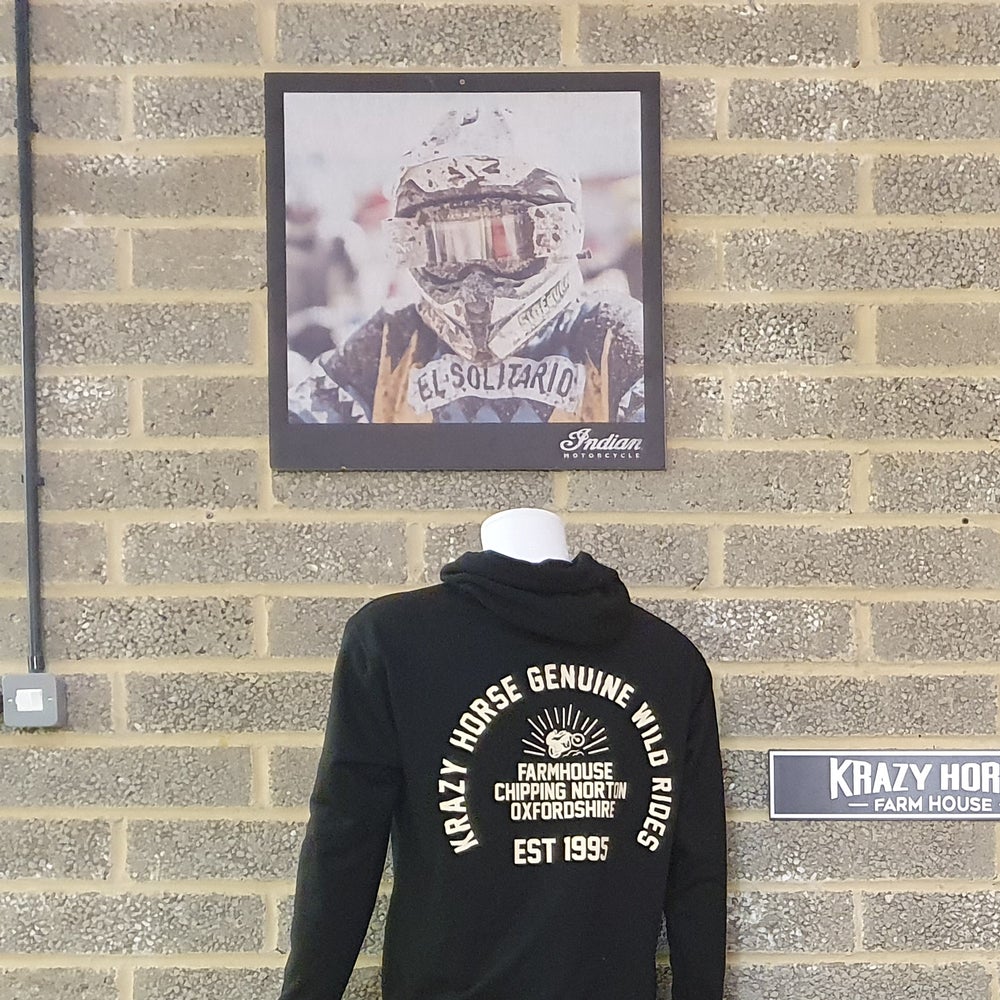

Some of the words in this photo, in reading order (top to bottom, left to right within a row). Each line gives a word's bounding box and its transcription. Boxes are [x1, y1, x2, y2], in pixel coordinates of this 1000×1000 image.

[560, 428, 643, 451] Indian
[526, 663, 635, 709] GENUINE
[449, 675, 523, 752] HORSE
[631, 701, 669, 767] WILD
[517, 762, 614, 781] FARMHOUSE
[830, 757, 933, 799] KRAZY
[438, 758, 479, 854] KRAZY
[494, 782, 567, 801] CHIPPING
[571, 781, 627, 800] NORTON
[874, 797, 923, 812] FARM
[929, 797, 993, 812] HOUSE
[510, 800, 616, 820] OXFORDSHIRE
[636, 777, 672, 852] RIDES
[513, 838, 557, 865] EST
[563, 835, 610, 861] 1995
